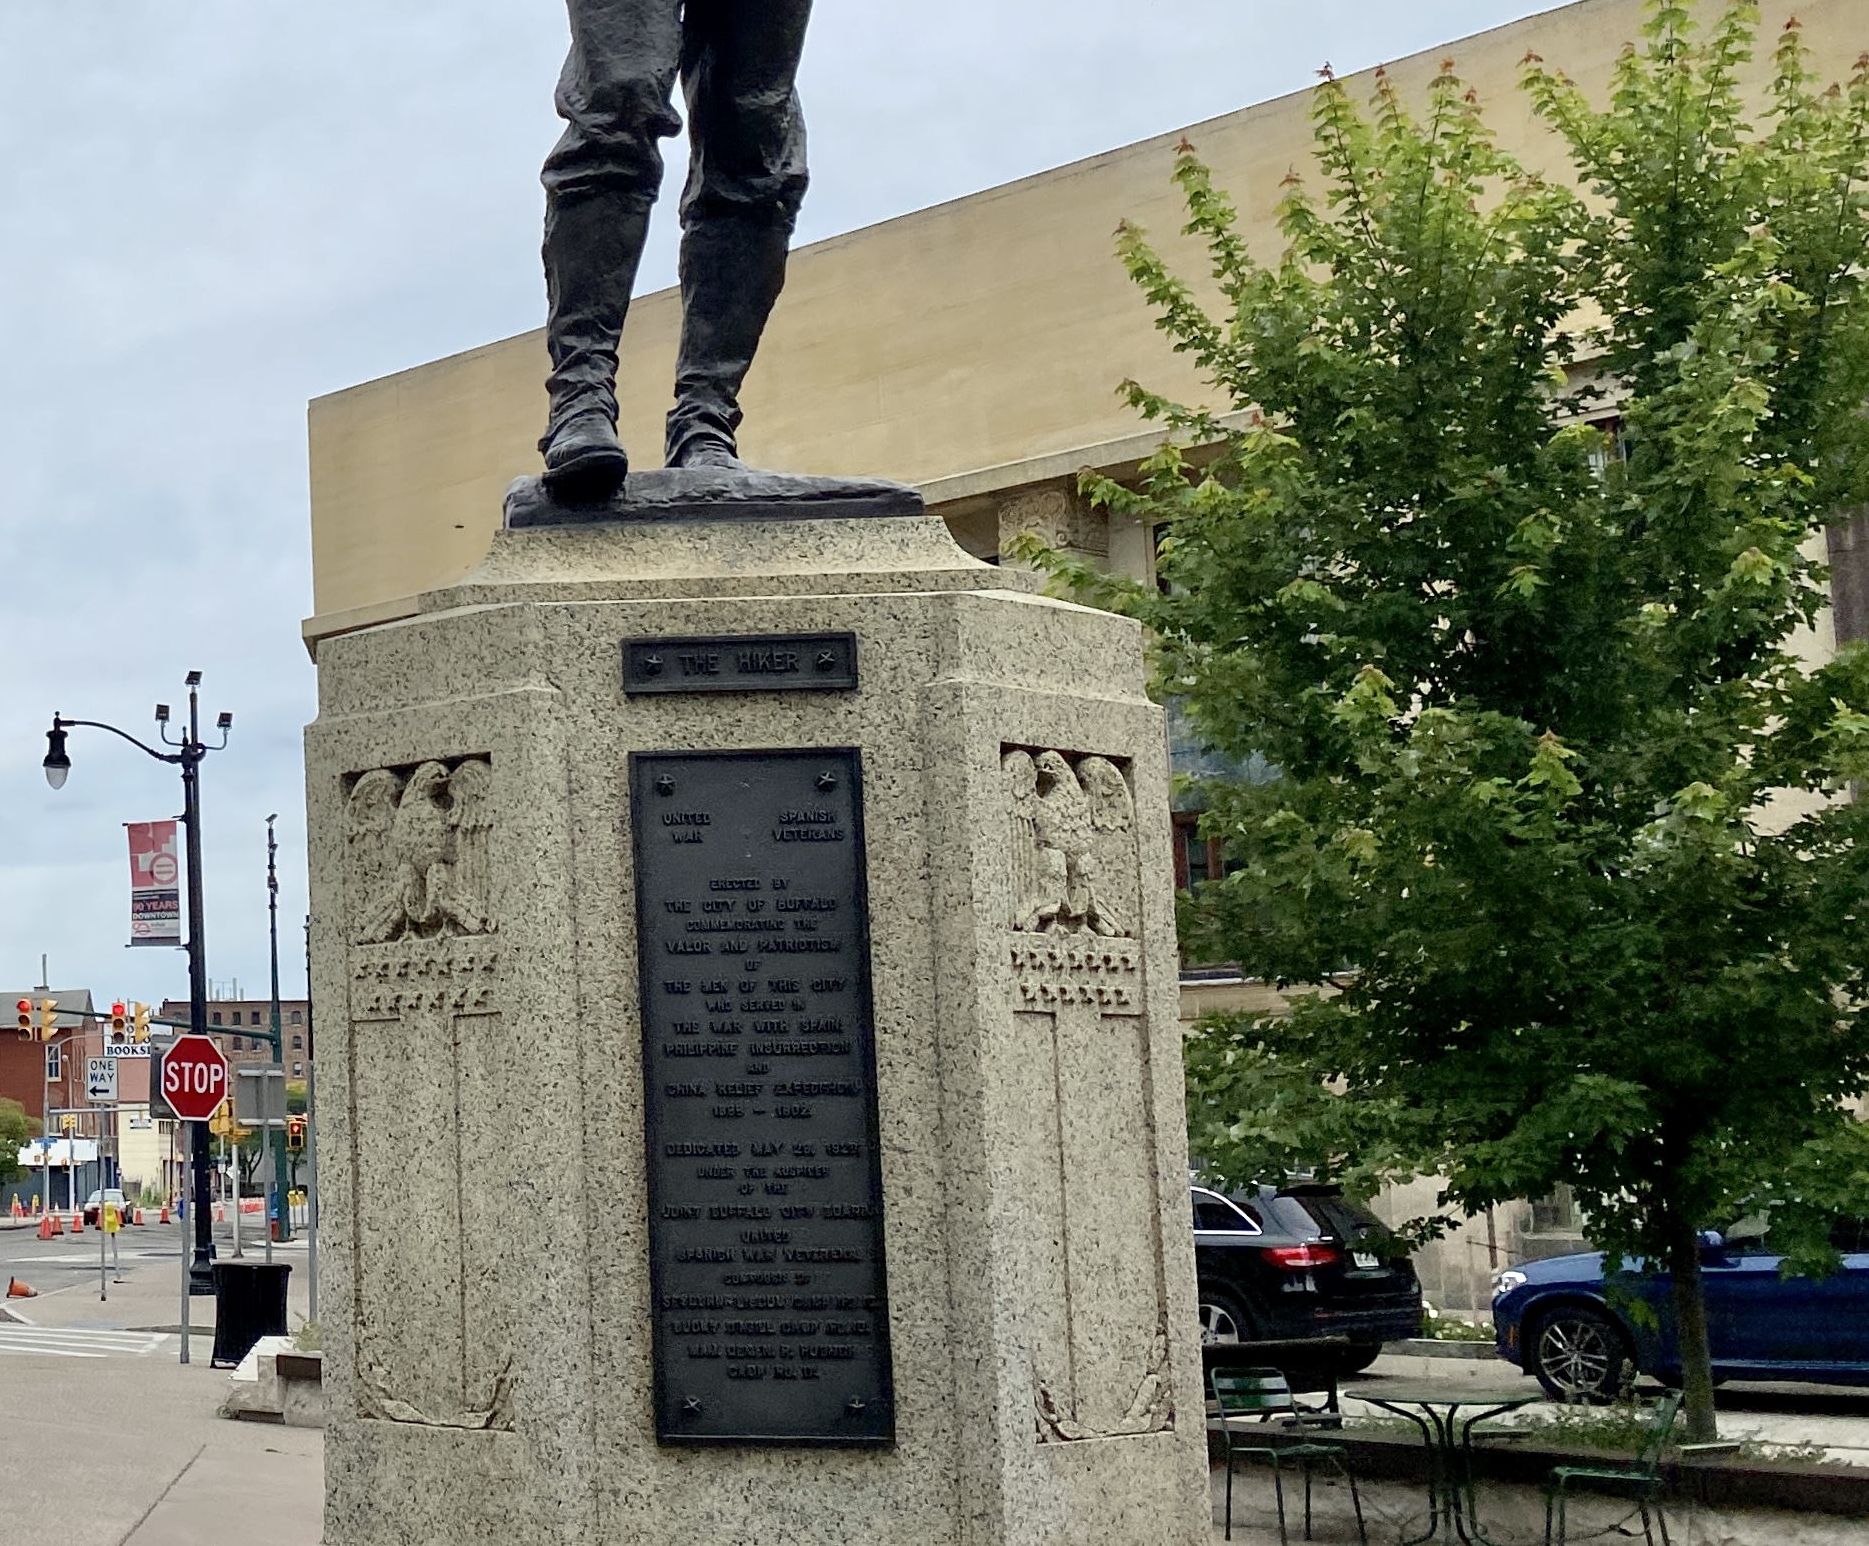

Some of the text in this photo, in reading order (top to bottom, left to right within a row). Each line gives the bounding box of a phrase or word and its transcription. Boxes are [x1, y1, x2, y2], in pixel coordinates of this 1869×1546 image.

[678, 651, 799, 675] THE HIKER
[662, 809, 836, 825] UNITED SPANISH
[672, 828, 845, 843] WAR VETERANS
[709, 877, 790, 891] ERECTED BY
[145, 901, 178, 911] YEARS
[664, 897, 838, 914] THE CITY OF BUFFALO
[133, 911, 178, 919] DOWNTOWN
[686, 918, 818, 932] COMMEMORATING THE
[665, 939, 712, 954] VALOR
[720, 939, 748, 954] AND
[745, 959, 762, 971] OF
[664, 978, 846, 993] THE MEN OF THIS CITY
[705, 1000, 732, 1012] WHO
[740, 999, 785, 1012] SERVED
[673, 1022, 700, 1035] THE
[709, 1021, 743, 1034] WAR
[753, 1019, 789, 1034] WITH
[664, 1041, 851, 1057] PHILIPPINE INSURRECTION
[91, 1060, 114, 1070] ONE
[90, 1073, 115, 1083] WAY
[165, 1061, 223, 1093] STOP
[666, 1142, 741, 1157] DEDICATED
